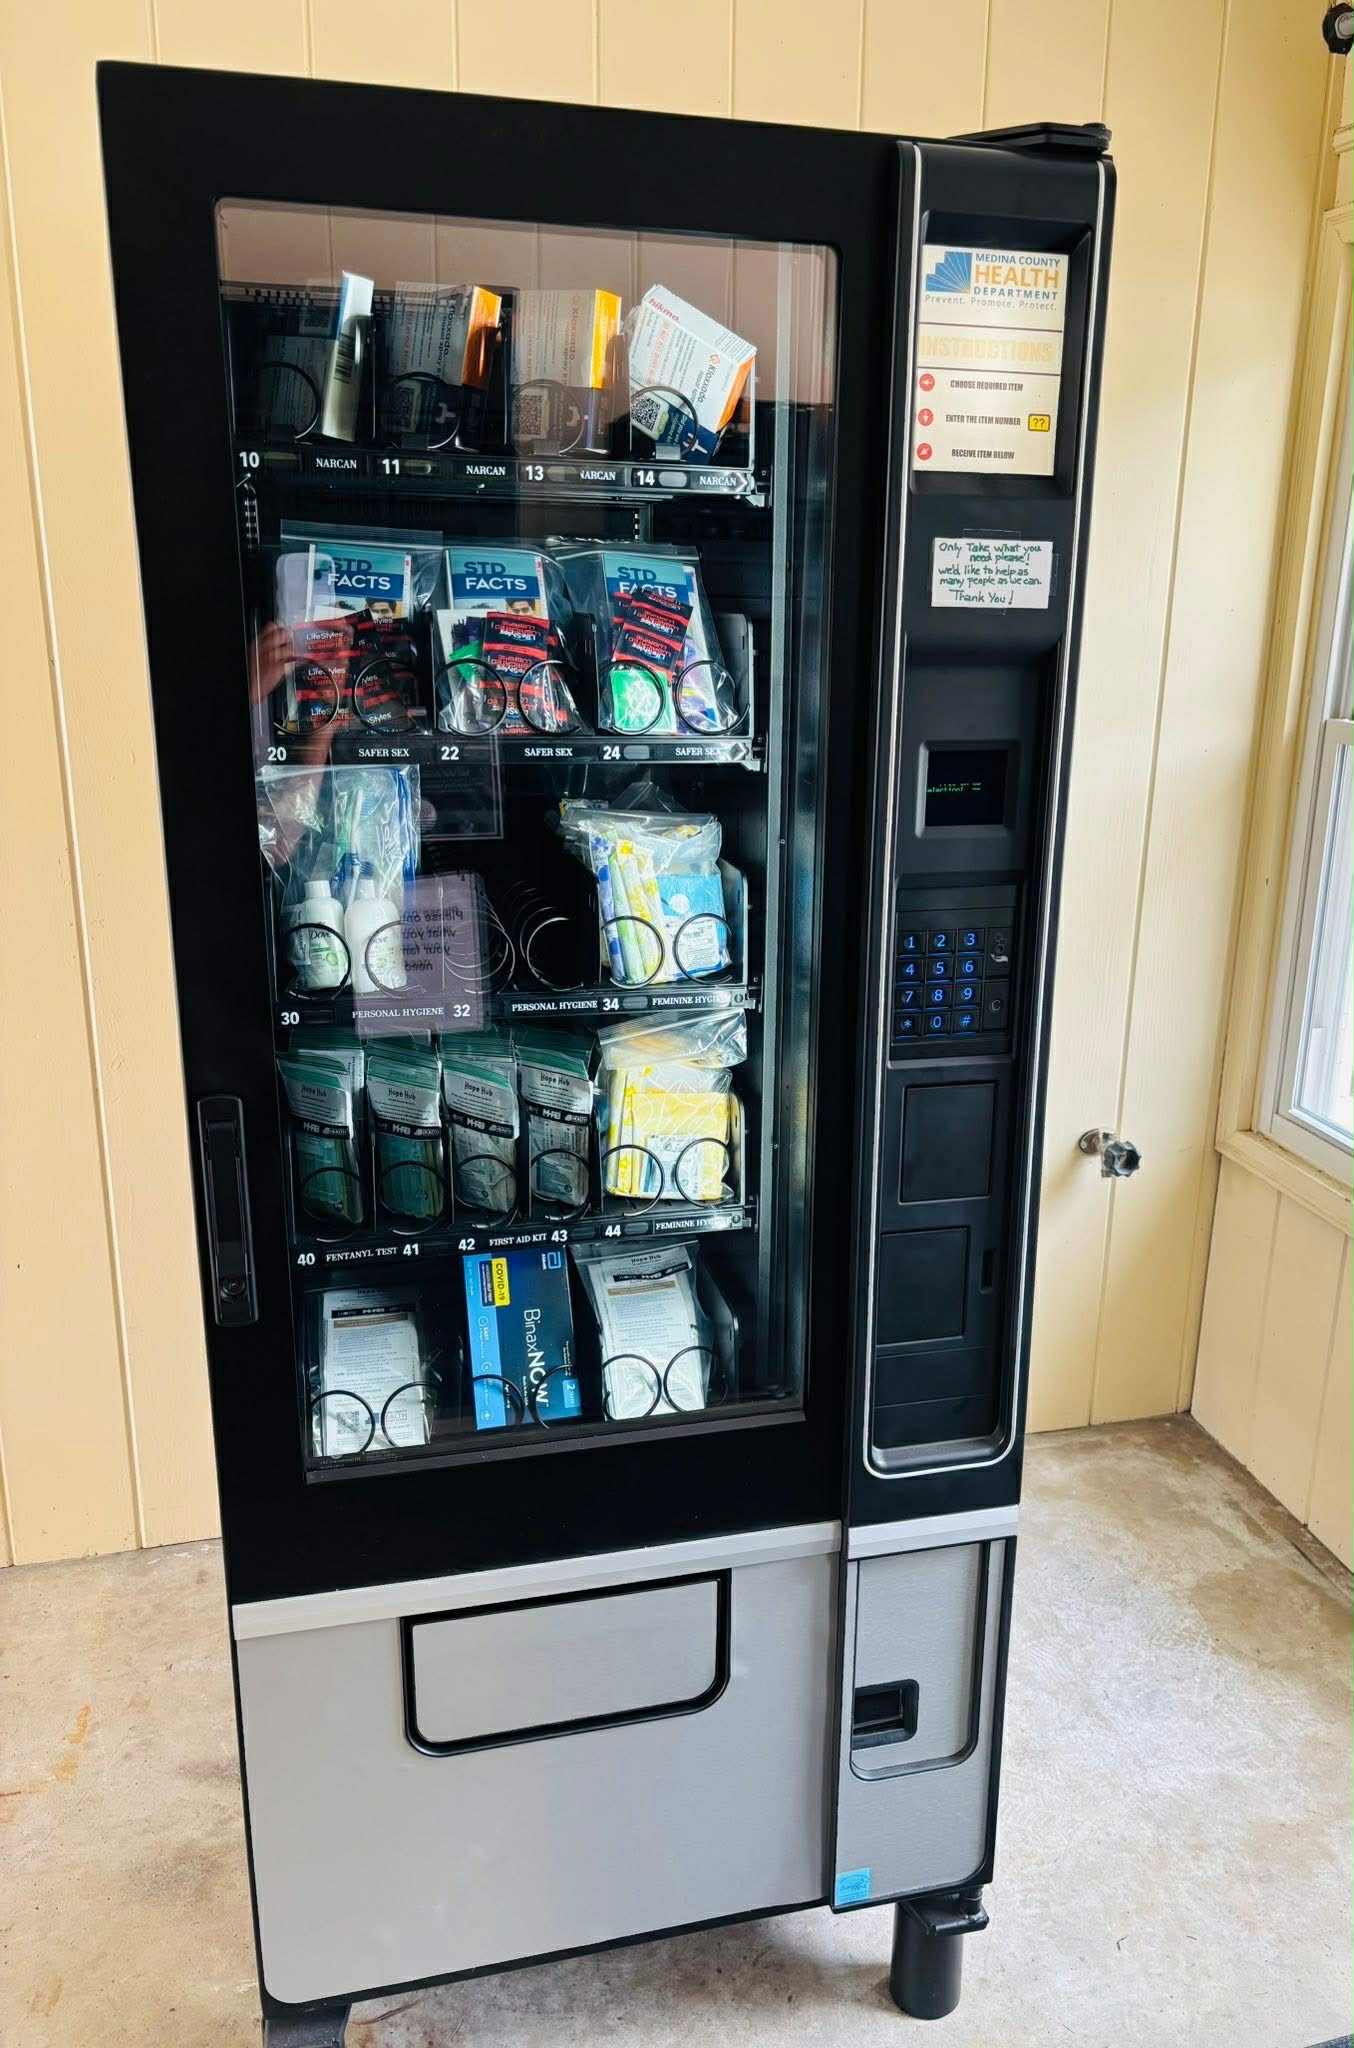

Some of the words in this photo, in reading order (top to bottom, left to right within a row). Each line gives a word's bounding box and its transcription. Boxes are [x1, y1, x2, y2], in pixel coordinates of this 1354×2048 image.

[975, 252, 1016, 265] MEDINA
[1018, 255, 1061, 268] COUNTY
[974, 264, 1061, 288] HEALTH
[973, 287, 1058, 301] DEPARTMENT
[921, 335, 1054, 363] INSTRUCTIONS
[950, 379, 976, 390] CHOOSE
[976, 380, 1007, 391] REQUIRED
[1008, 382, 1024, 392] ITEM
[945, 414, 966, 424] ENTER
[966, 415, 977, 424] THE
[977, 415, 994, 425] ITEM
[994, 416, 1021, 426] NUMBER
[239, 451, 260, 469] 10
[951, 448, 977, 459] RECEIVE
[977, 449, 993, 459] ITEM
[993, 451, 1015, 461] BELOW
[316, 457, 358, 470] NARCAN
[382, 459, 400, 475] 11
[466, 464, 506, 477] NARCAN
[525, 466, 544, 482] 13
[636, 470, 656, 487] 14
[699, 475, 737, 487] NARCAN
[938, 542, 962, 559] Only
[966, 543, 990, 553] Take
[994, 543, 1021, 553] what
[1023, 544, 1042, 557] you
[329, 557, 373, 573] STD
[969, 552, 992, 562] need
[995, 553, 1030, 566] please!
[463, 561, 506, 576] STD
[617, 566, 657, 582] STD
[964, 565, 981, 576] like
[983, 566, 994, 576] to
[995, 566, 1017, 580] help
[1017, 568, 1029, 576] as
[327, 573, 391, 590] FACTS
[465, 577, 528, 591] FACTS
[939, 577, 965, 588] many
[967, 577, 996, 588] people
[1023, 577, 1042, 585] can.
[949, 588, 985, 603] Thank
[305, 629, 345, 642] LifeStyles
[267, 746, 287, 762] 20
[358, 747, 389, 758] SAFER
[391, 747, 410, 757] SEX
[441, 745, 460, 761] 22
[524, 746, 553, 757] SAFER
[554, 747, 573, 757] SEX
[602, 745, 621, 760] 24
[675, 746, 704, 757] SAFER
[907, 936, 915, 949] 1
[936, 935, 945, 947] 2
[967, 933, 975, 945] 3
[905, 964, 914, 976] 4
[935, 962, 944, 974] 5
[965, 960, 974, 973] 6
[652, 995, 693, 1006] FEMININE
[904, 991, 913, 1003] 7
[934, 989, 943, 1001] 8
[964, 988, 972, 1000] 9
[453, 1004, 471, 1018] 32
[511, 1002, 558, 1013] PERSONAL
[559, 1000, 598, 1010] HYGIENE
[602, 998, 620, 1011] 34
[280, 1012, 300, 1026] 30
[352, 1008, 400, 1020] PERSONAL
[402, 1006, 445, 1018] HYGIENE
[933, 1016, 942, 1028] 0
[604, 1224, 622, 1237] 44
[655, 1219, 695, 1231] FEMININE
[489, 1236, 514, 1247] FIRST
[516, 1235, 531, 1245] AID
[531, 1232, 548, 1242] KIT
[551, 1229, 568, 1243] 43
[402, 1243, 420, 1257] 41
[458, 1238, 475, 1251] 42
[297, 1253, 315, 1266] 40
[326, 1249, 374, 1263] FENTANYL
[375, 1246, 398, 1256] TEST
[495, 1262, 505, 1301] COVID-19
[565, 1383, 575, 1392] 2
